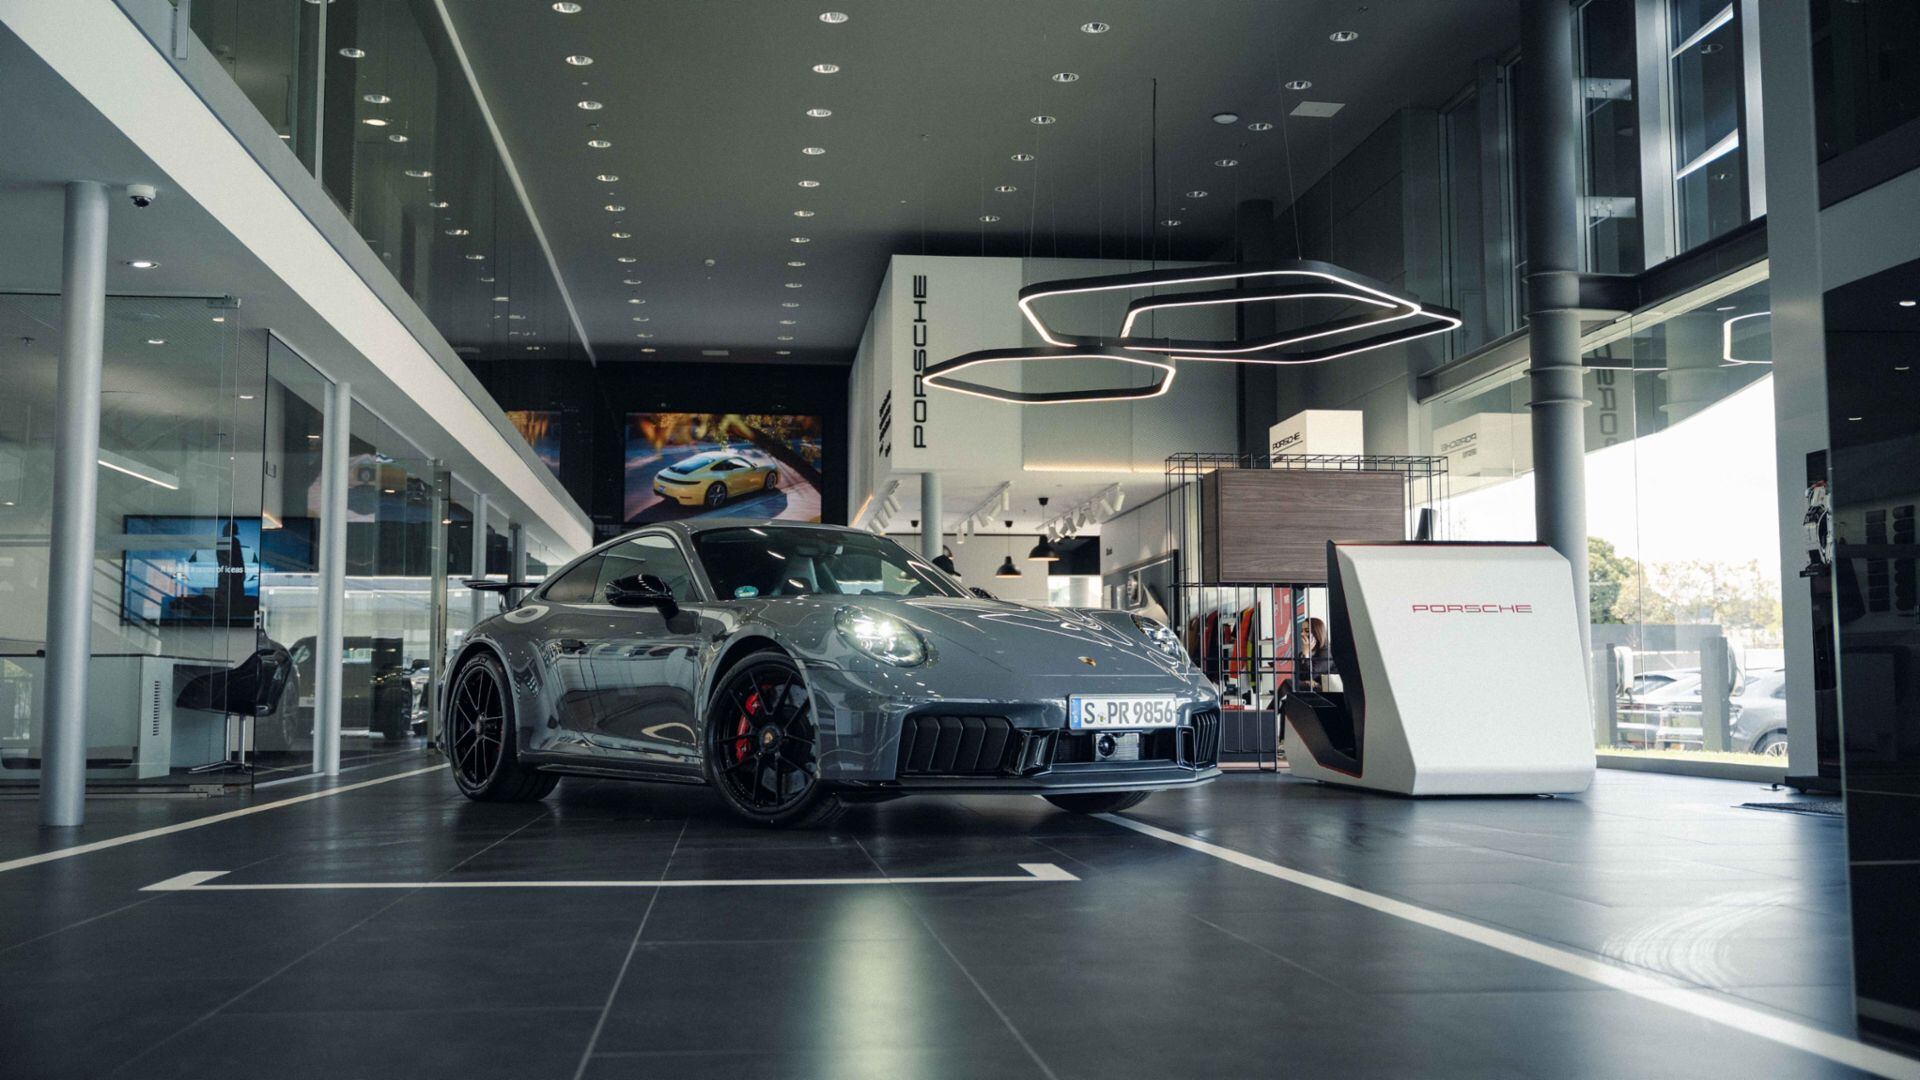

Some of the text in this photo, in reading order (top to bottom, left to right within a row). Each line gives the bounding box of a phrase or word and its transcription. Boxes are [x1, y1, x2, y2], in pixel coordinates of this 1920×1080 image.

[913, 275, 927, 448] PORSCHE
[1272, 432, 1300, 450] PORSCHE
[1412, 604, 1533, 613] PORSCHE
[1133, 701, 1173, 723] 9856
